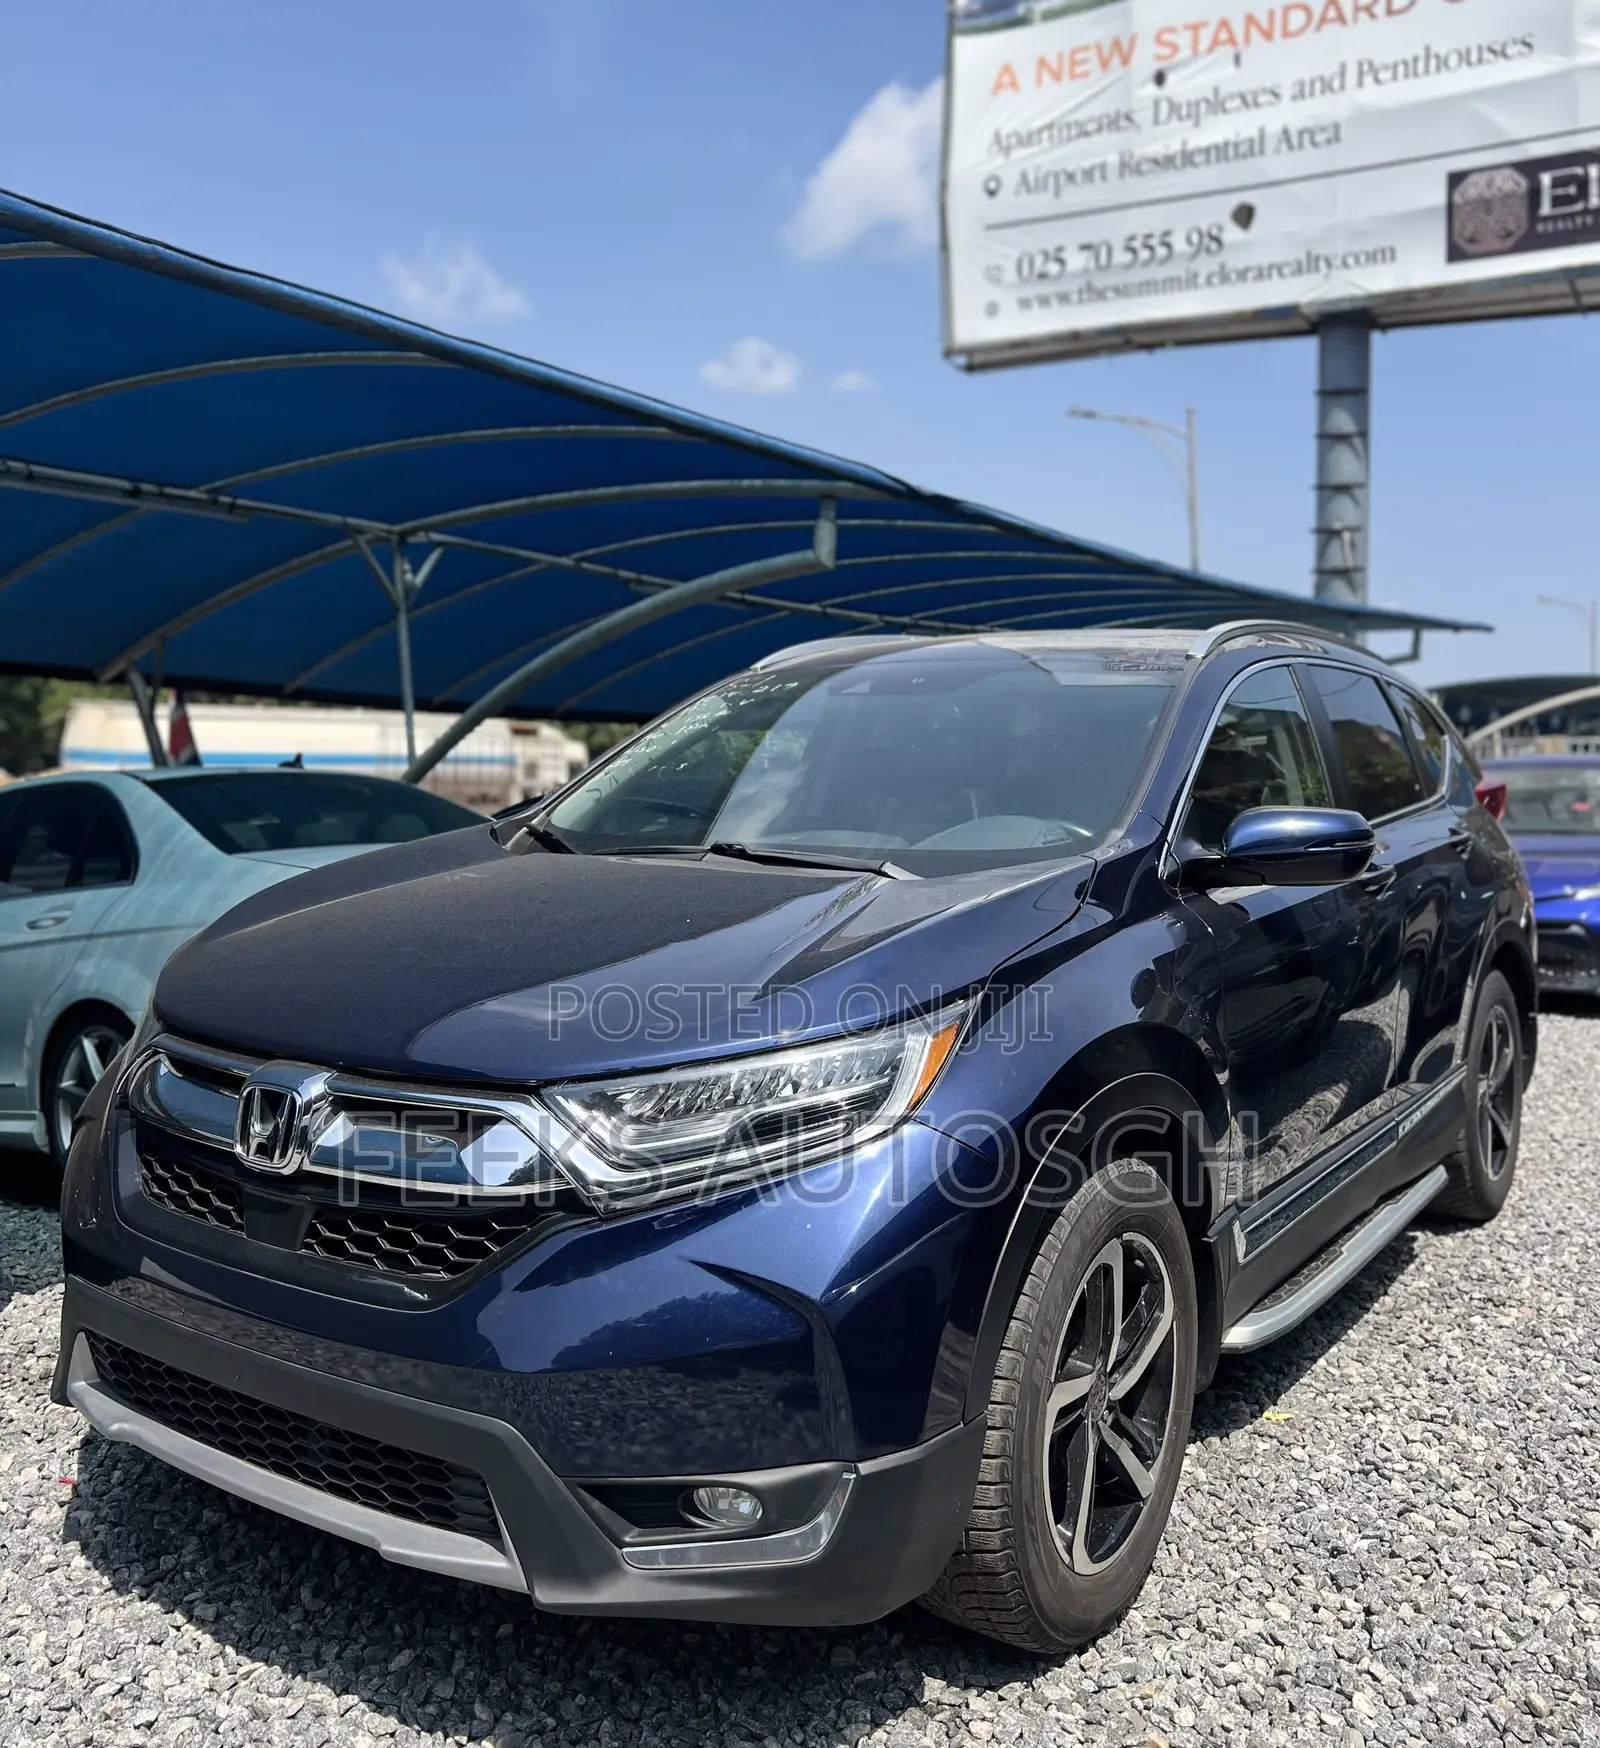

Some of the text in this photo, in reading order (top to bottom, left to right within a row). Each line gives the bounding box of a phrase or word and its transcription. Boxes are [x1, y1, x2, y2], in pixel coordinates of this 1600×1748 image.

[991, 62, 1021, 97] A
[1034, 33, 1139, 88] NEW
[1153, 84, 1282, 129] Duplexes
[1291, 61, 1348, 103] and
[1355, 31, 1536, 89] Penthouses
[1013, 120, 1342, 199] Airport Residential Area
[1015, 222, 1226, 284] 025 70 555 98
[1015, 244, 1398, 312] www.thesummit.elorarealty.com
